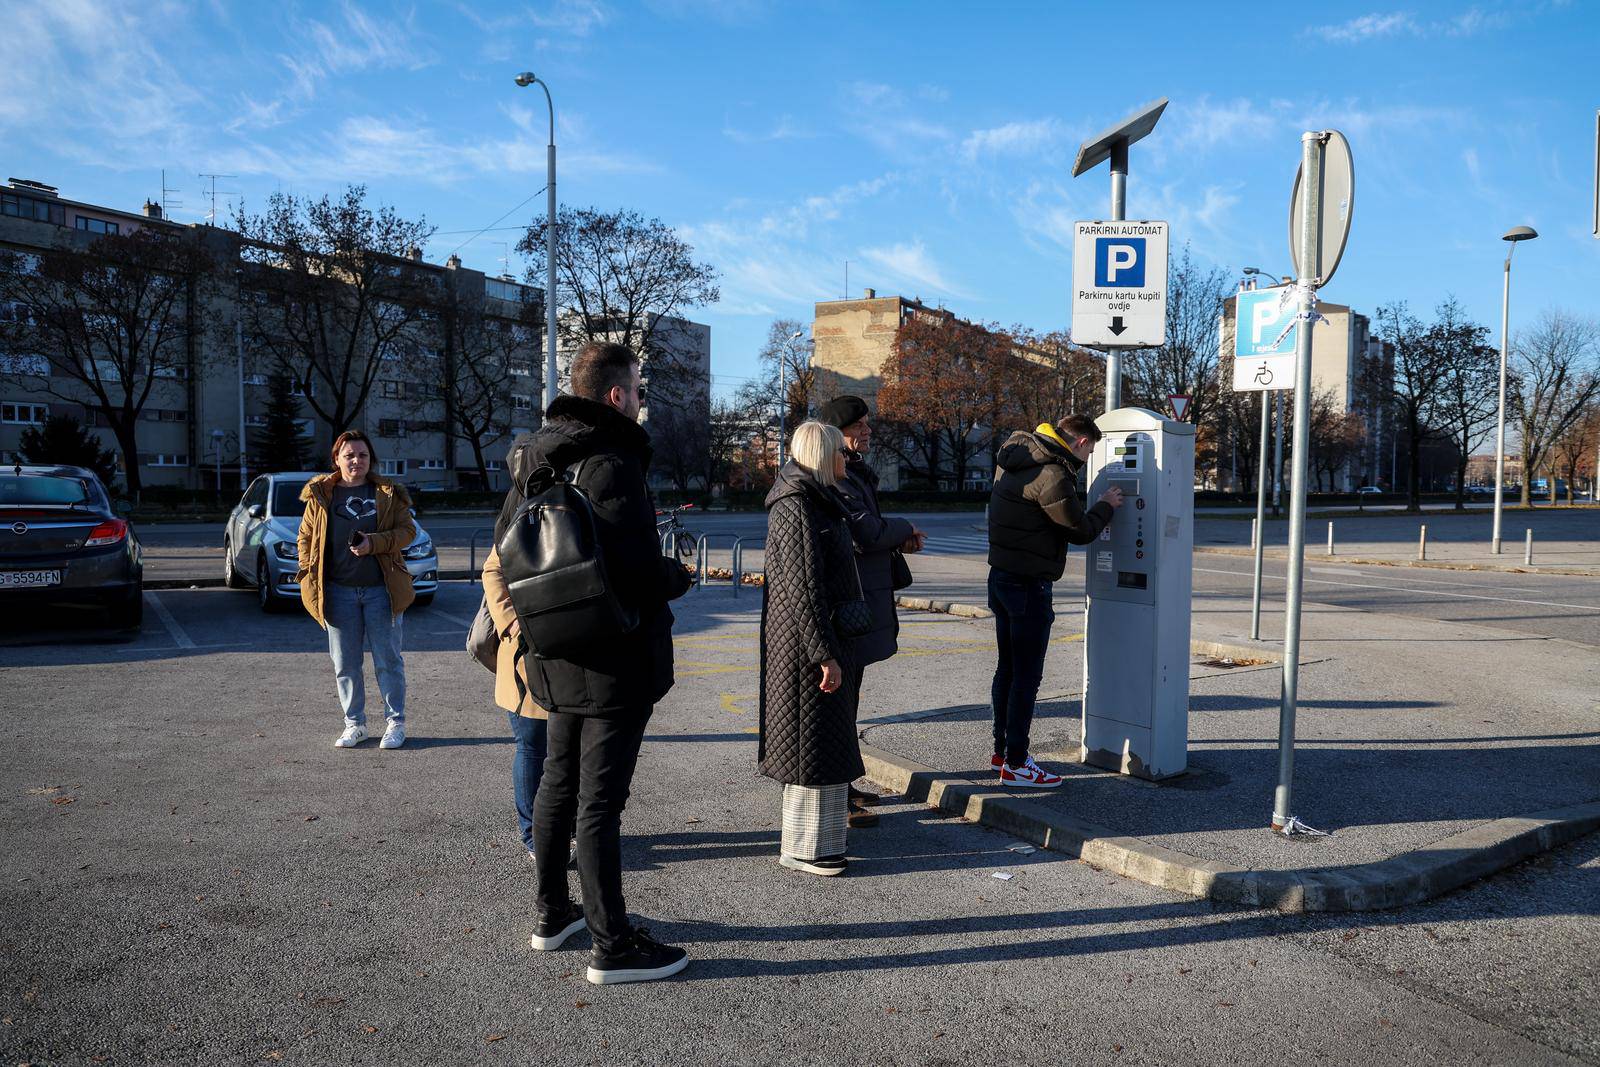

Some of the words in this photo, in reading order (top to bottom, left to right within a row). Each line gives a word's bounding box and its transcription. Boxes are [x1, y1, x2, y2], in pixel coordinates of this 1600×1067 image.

[1079, 226, 1119, 235] PARKIRNI
[1122, 226, 1162, 235] AUTOMAT
[1107, 245, 1137, 282] P
[1079, 290, 1113, 300] Parkirnu
[1115, 291, 1136, 300] kartu
[1138, 291, 1160, 302] kupiti
[1108, 302, 1131, 312] ovdje
[1252, 302, 1281, 343] P
